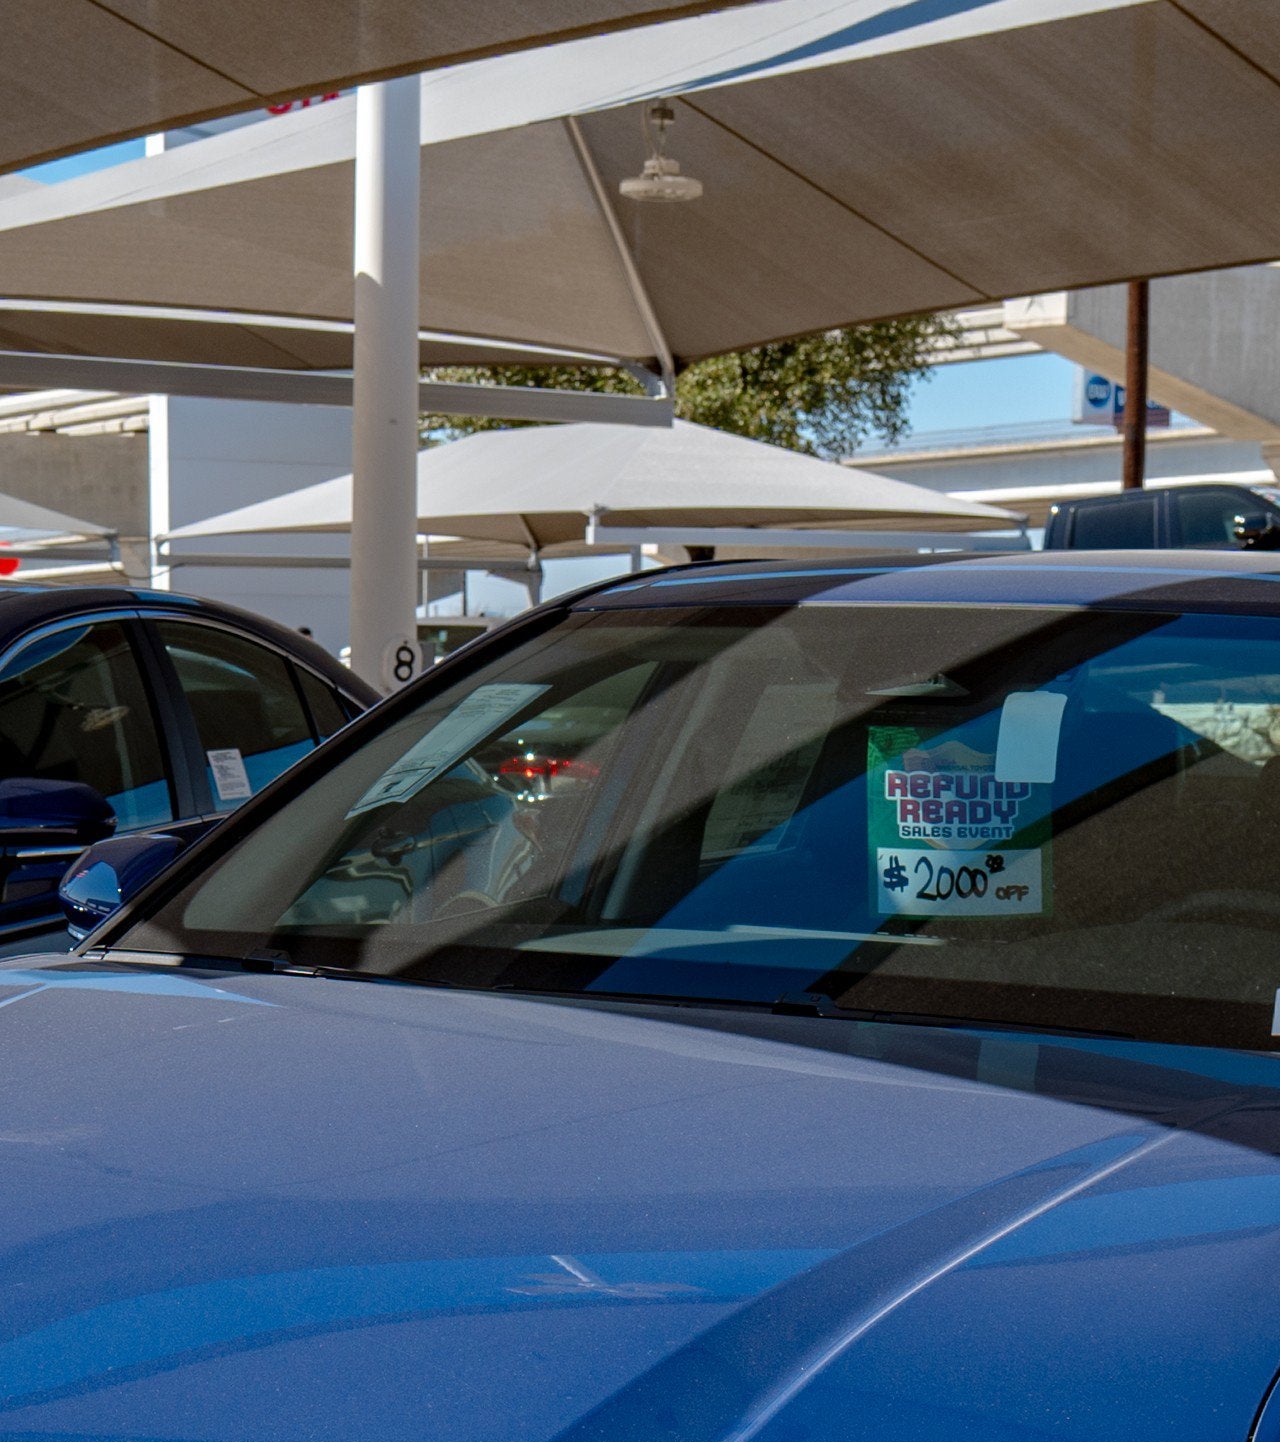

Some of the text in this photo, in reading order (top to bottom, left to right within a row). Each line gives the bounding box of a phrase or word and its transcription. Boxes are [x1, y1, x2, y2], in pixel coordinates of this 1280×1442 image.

[395, 646, 414, 682] 8
[887, 772, 1030, 800] REFUND
[899, 800, 1017, 825] READY
[901, 825, 1013, 839] SALES EVENT
[995, 884, 1030, 901] OFF
